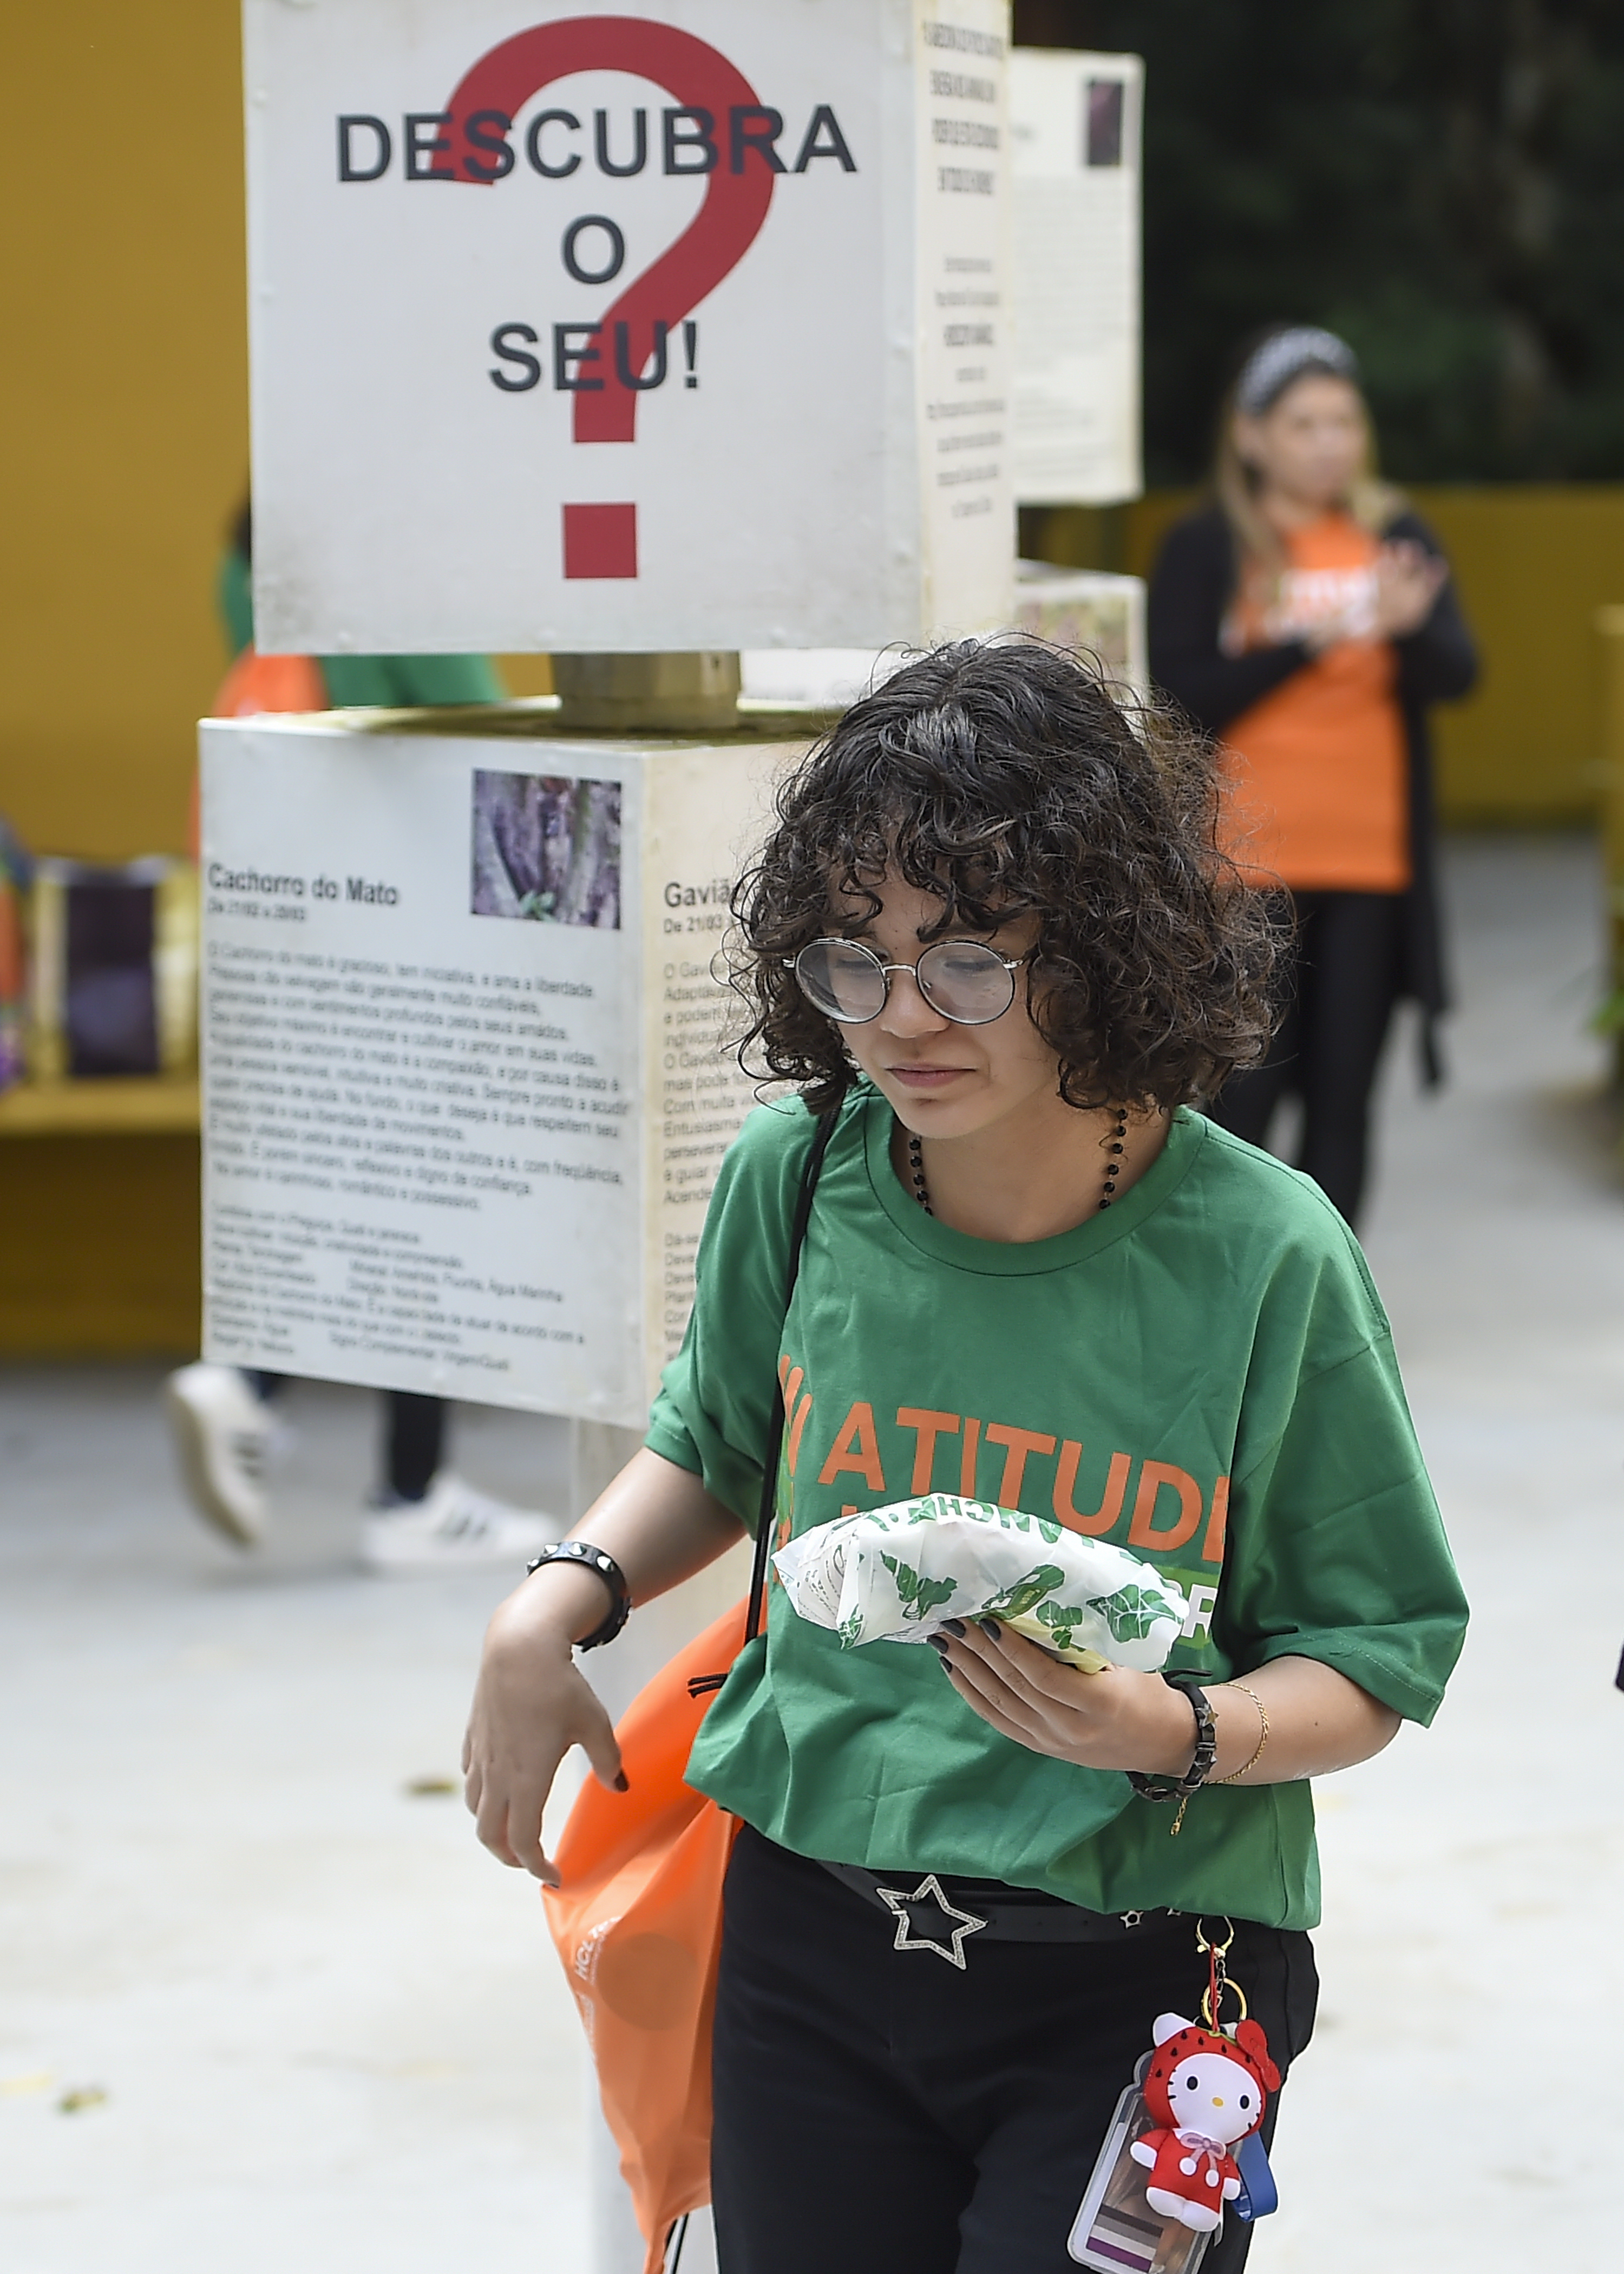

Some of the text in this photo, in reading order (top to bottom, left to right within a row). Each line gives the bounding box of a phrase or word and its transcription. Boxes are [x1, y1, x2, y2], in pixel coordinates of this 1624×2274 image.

[337, 104, 857, 181] DESCUBRA
[562, 214, 625, 284] O
[489, 321, 698, 391] SEU!
[209, 864, 398, 905] Cachorro do Mato
